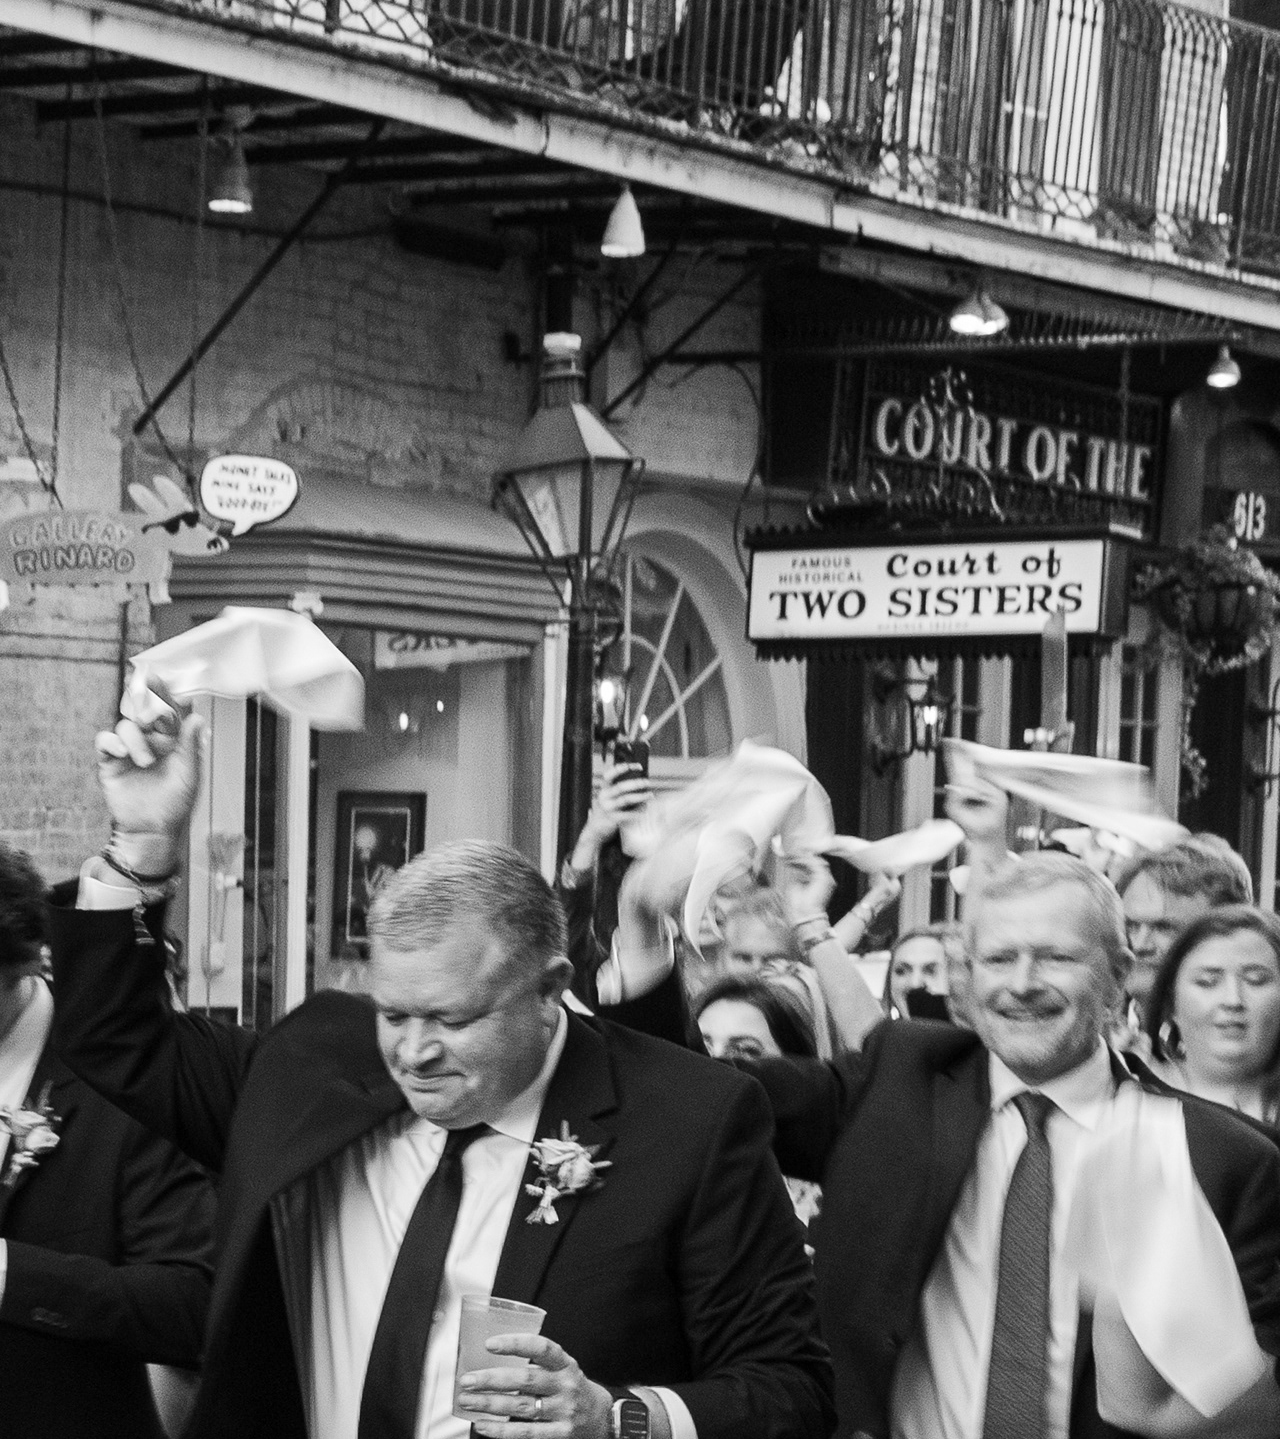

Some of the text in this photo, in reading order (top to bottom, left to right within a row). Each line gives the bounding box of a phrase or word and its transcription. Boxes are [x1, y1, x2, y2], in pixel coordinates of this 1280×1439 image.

[875, 398, 1151, 501] COURT OF THE
[1233, 492, 1266, 541] 613
[13, 543, 135, 576] RINARD
[791, 557, 852, 568] FAMOUS
[886, 547, 1061, 578] Court of
[779, 571, 863, 584] HISTORICAL
[769, 582, 1082, 620] TWO SISTERS
